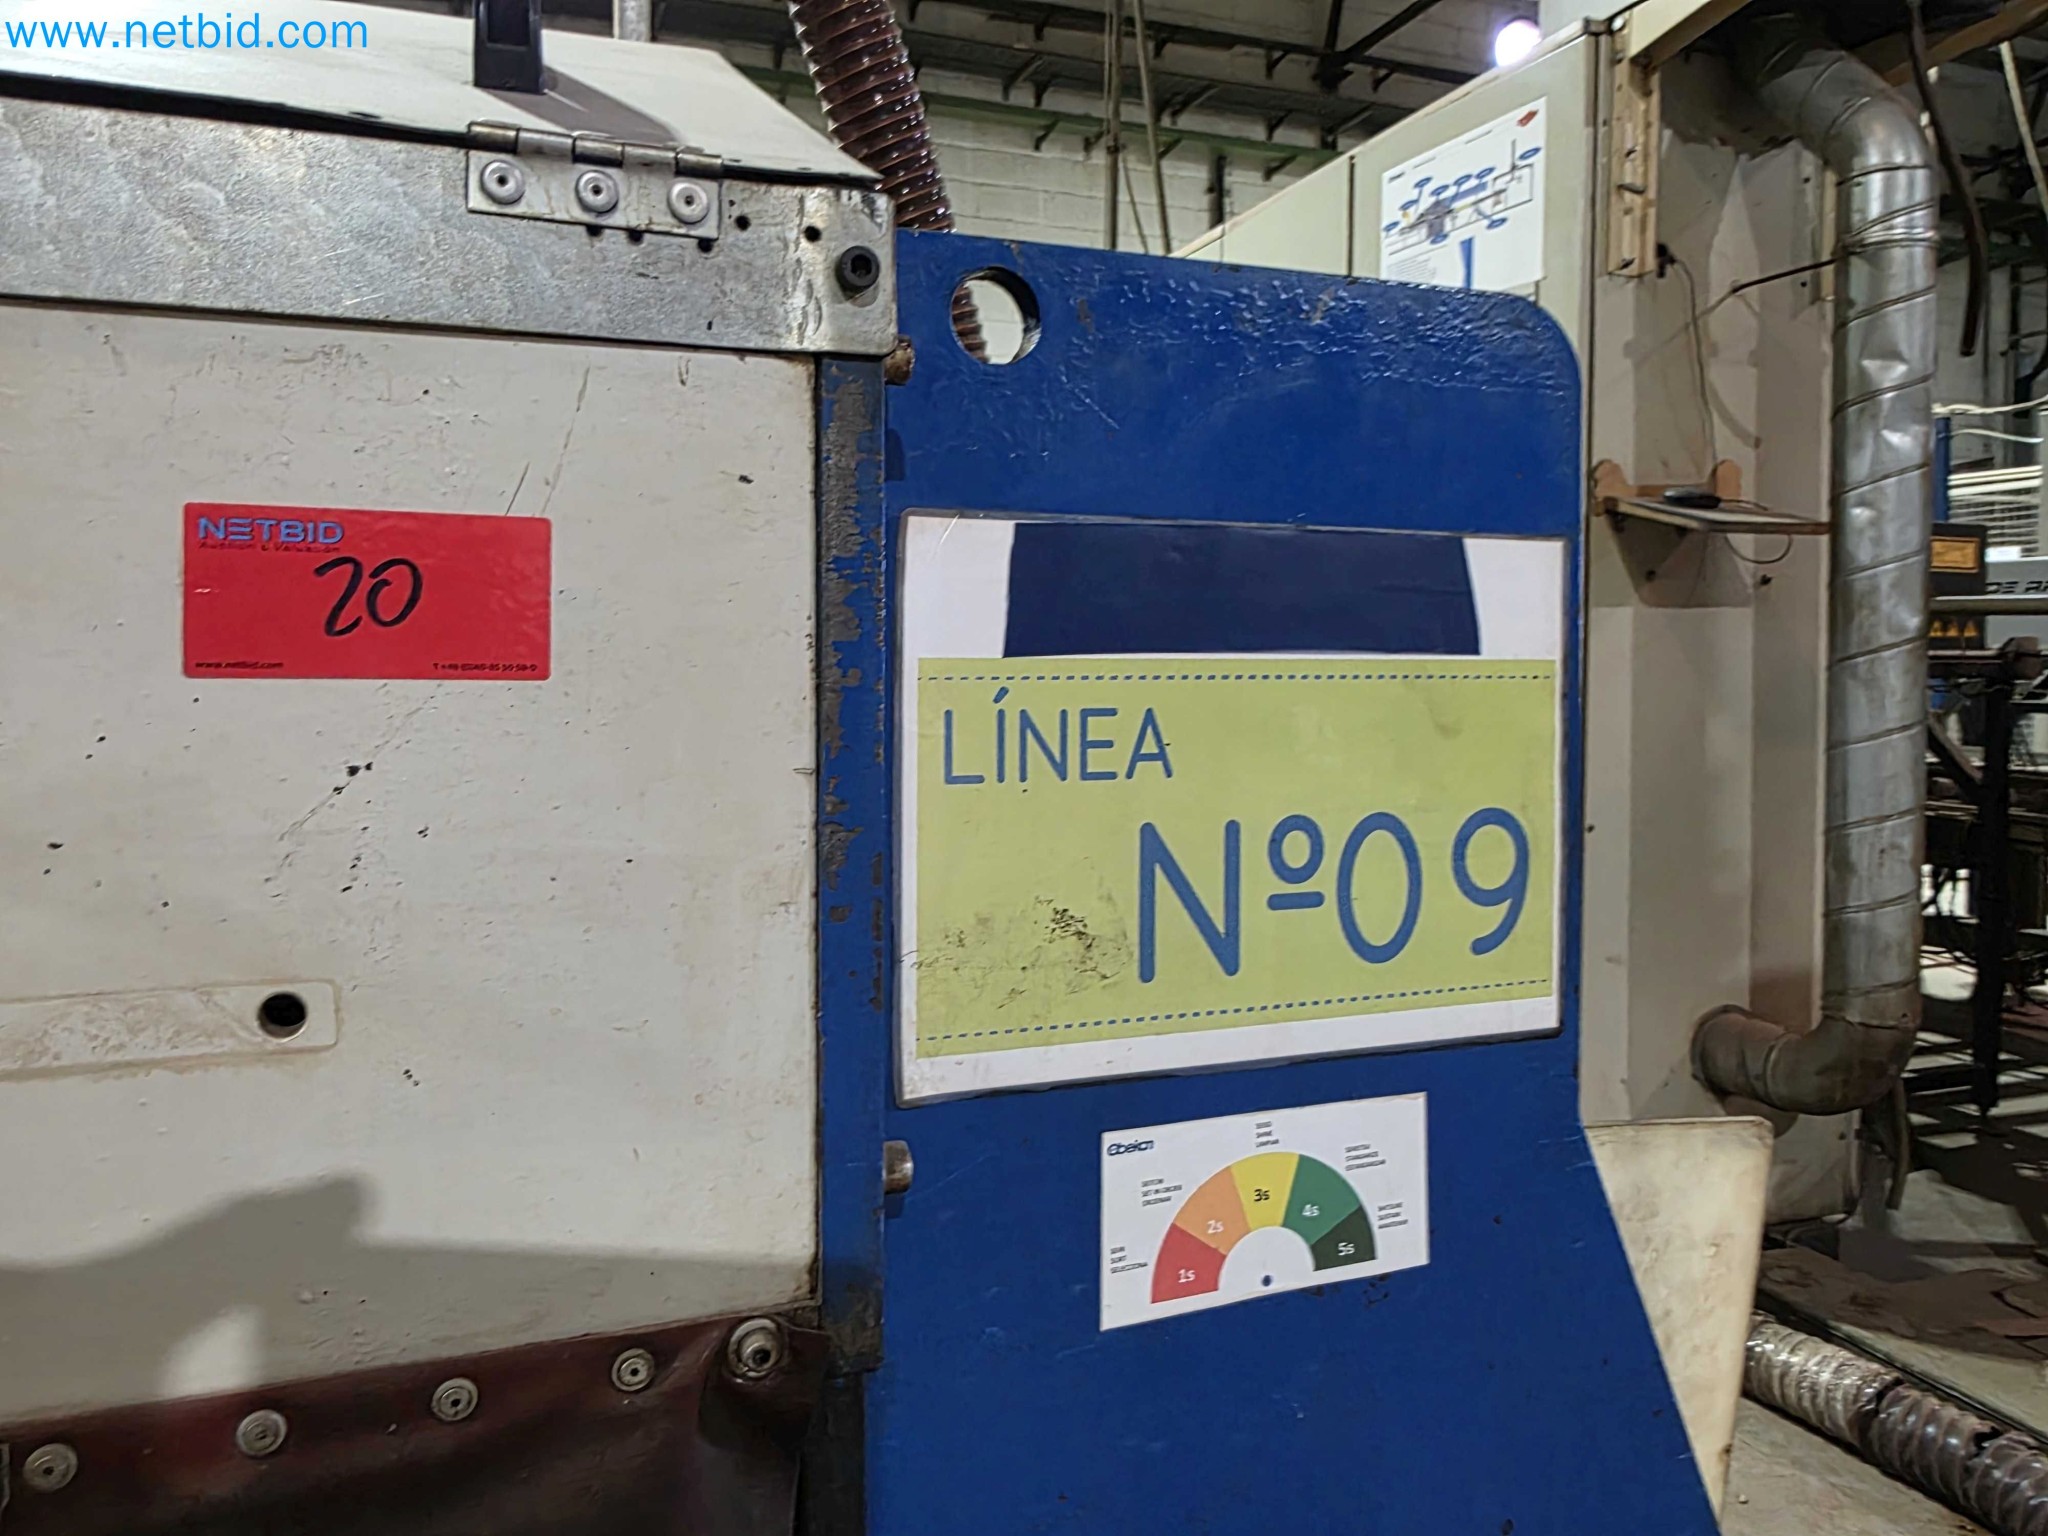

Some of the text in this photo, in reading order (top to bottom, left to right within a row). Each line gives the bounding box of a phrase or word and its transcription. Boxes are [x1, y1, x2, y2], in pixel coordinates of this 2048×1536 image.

[198, 516, 344, 545] NETBID
[313, 555, 423, 637] 20
[944, 687, 1173, 785] LÍNEA
